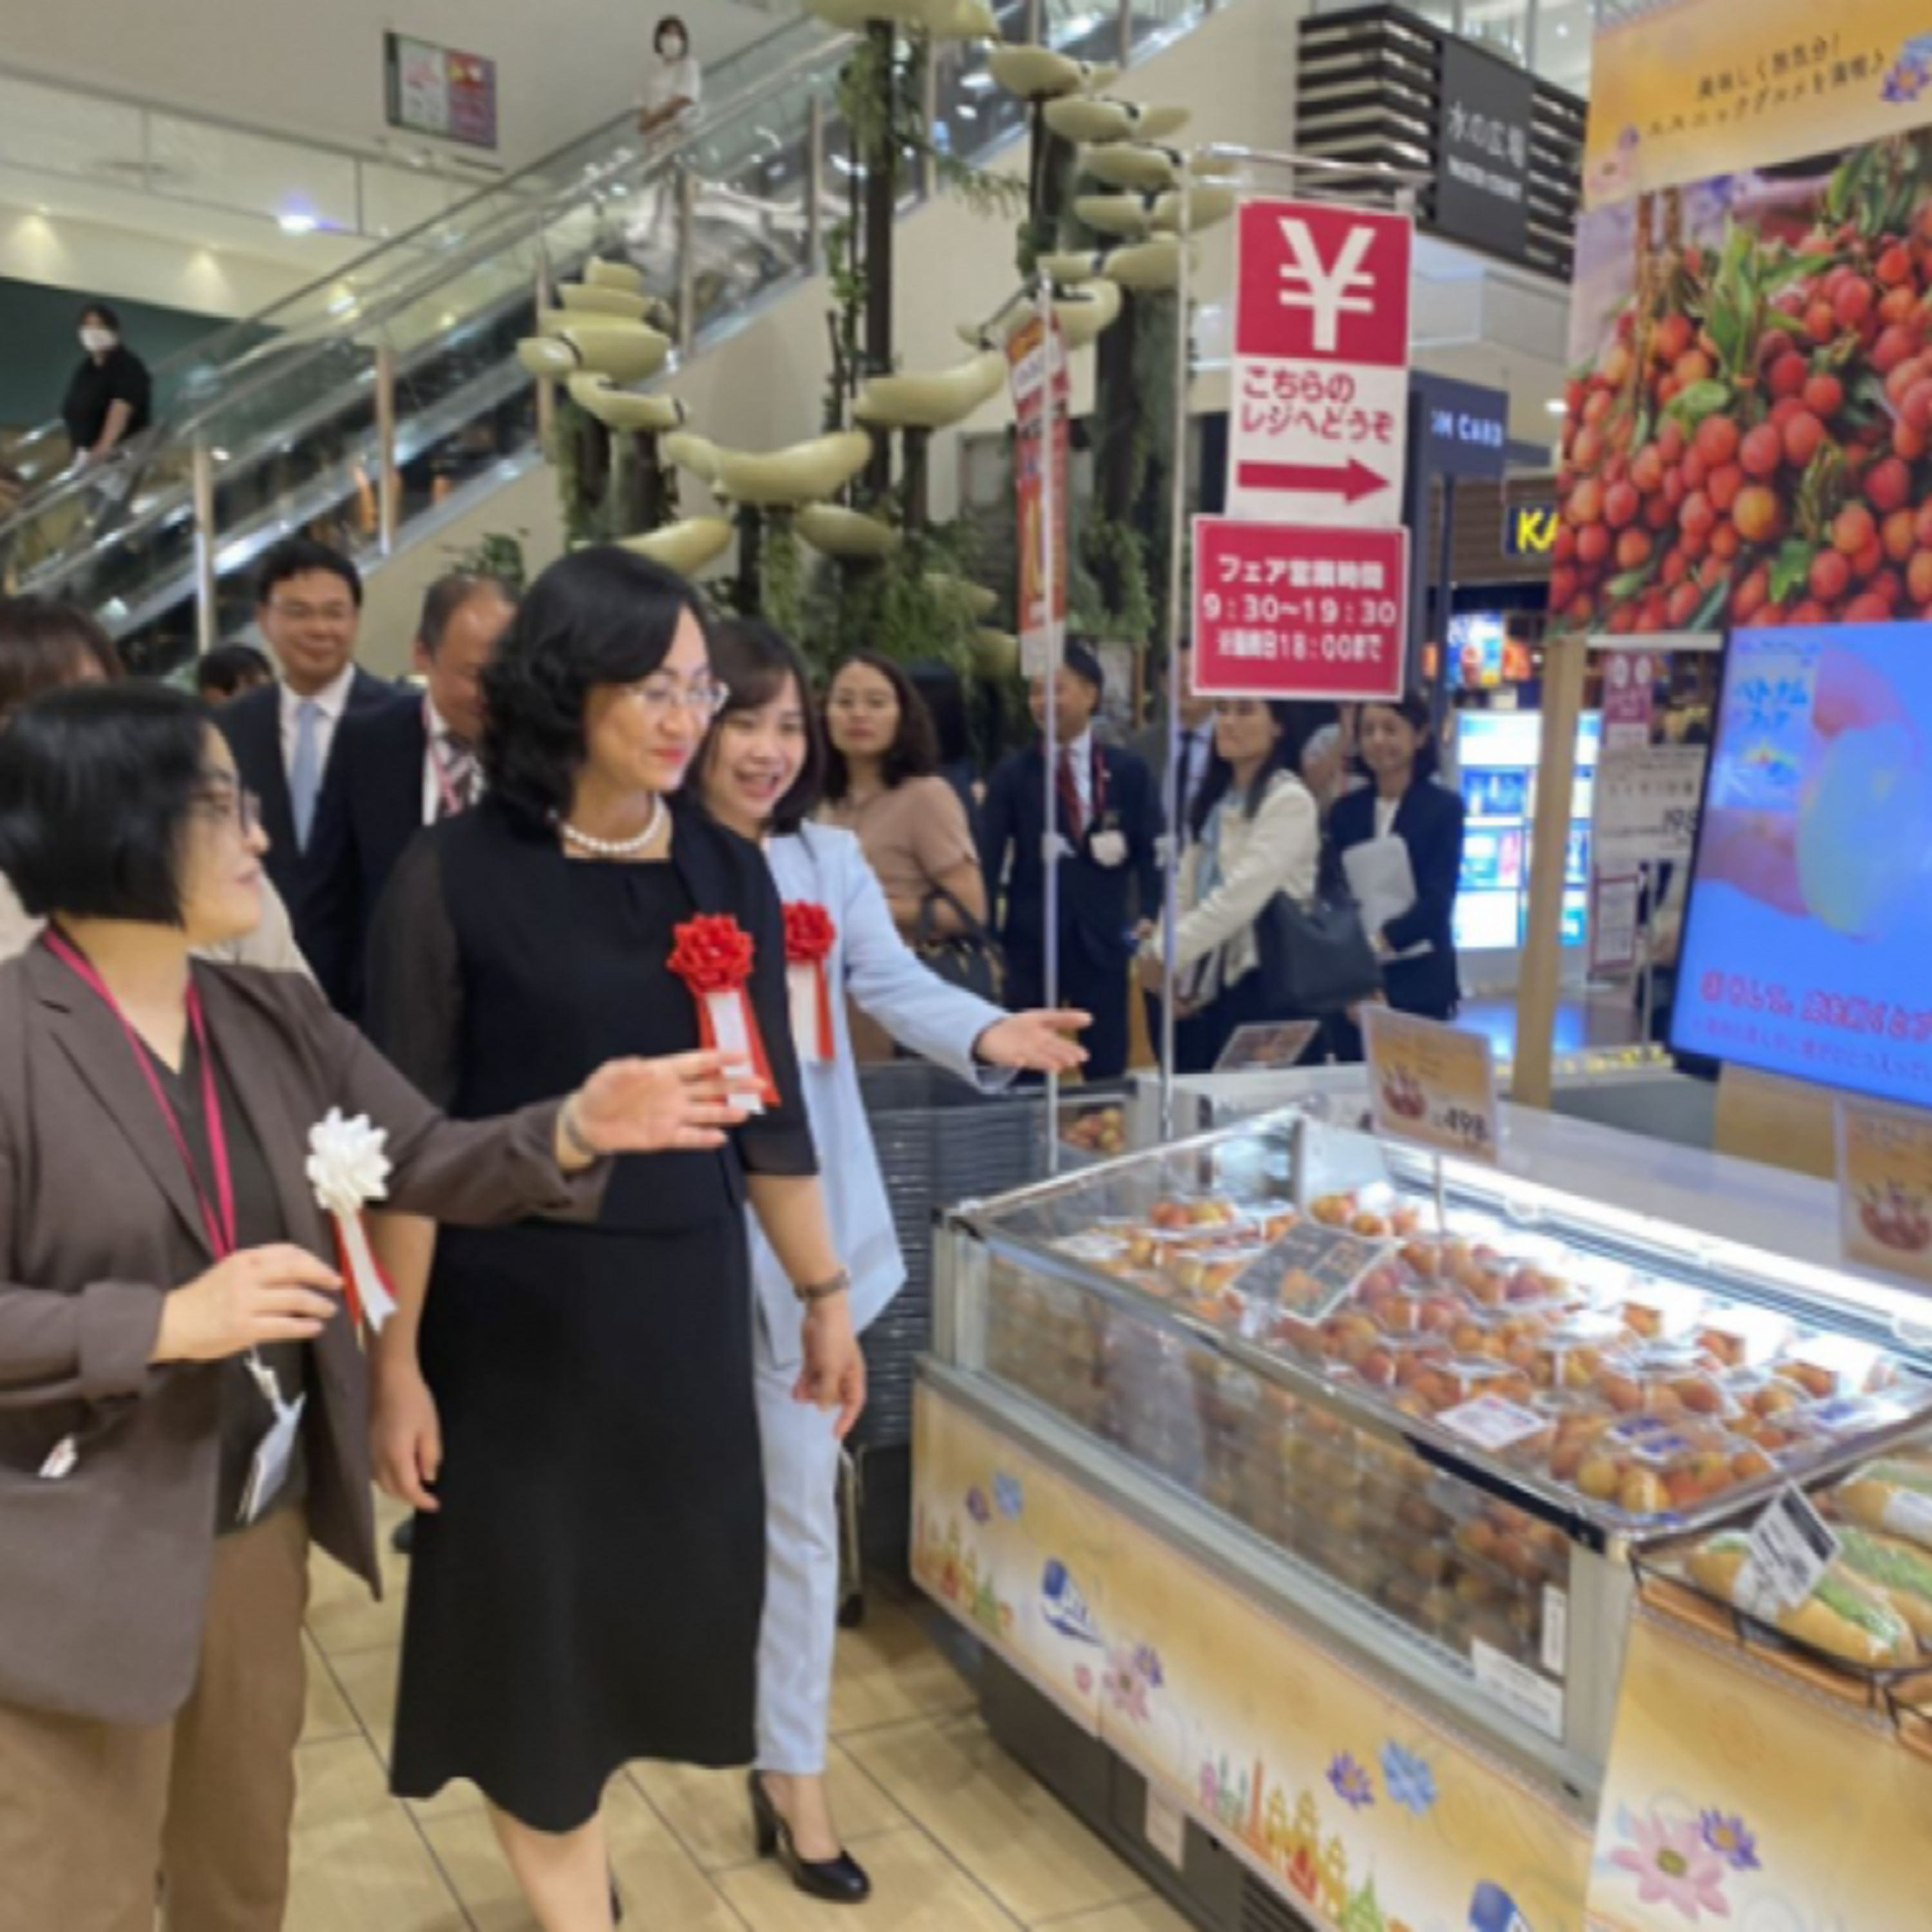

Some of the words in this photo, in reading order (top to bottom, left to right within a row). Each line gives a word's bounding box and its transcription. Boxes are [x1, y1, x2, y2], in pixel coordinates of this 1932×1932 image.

[1243, 365, 1356, 404] こちらの
[1240, 402, 1396, 445] レジへどうぞ
